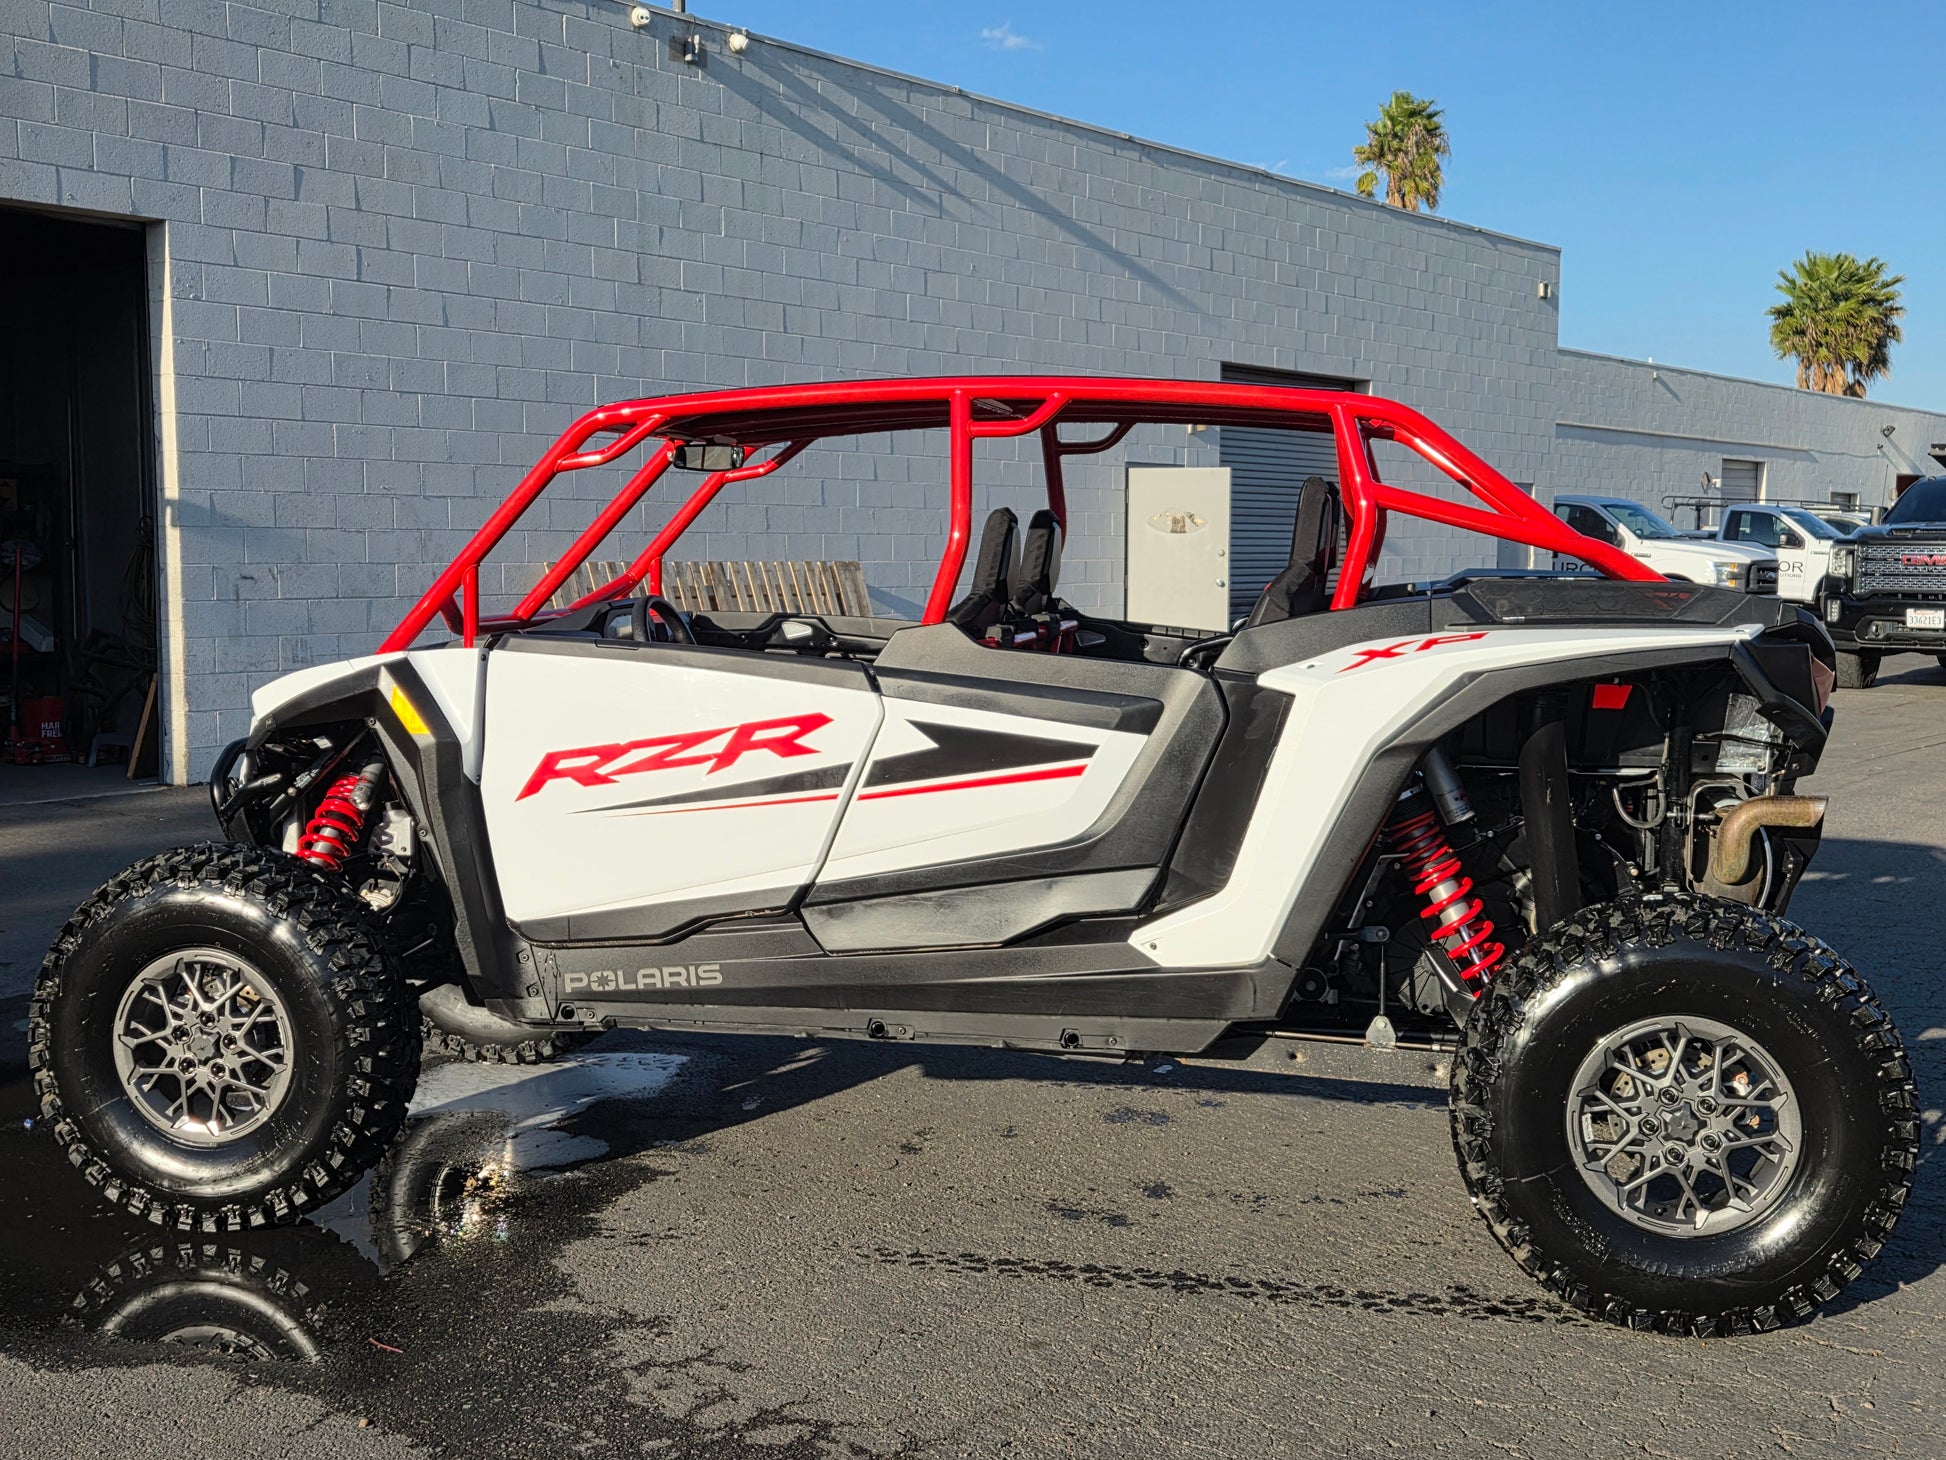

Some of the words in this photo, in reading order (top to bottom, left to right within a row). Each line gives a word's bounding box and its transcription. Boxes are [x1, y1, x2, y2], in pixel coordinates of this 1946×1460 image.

[1335, 632, 1490, 674] XP
[515, 712, 834, 802] RZR
[564, 963, 723, 993] POLARIS
